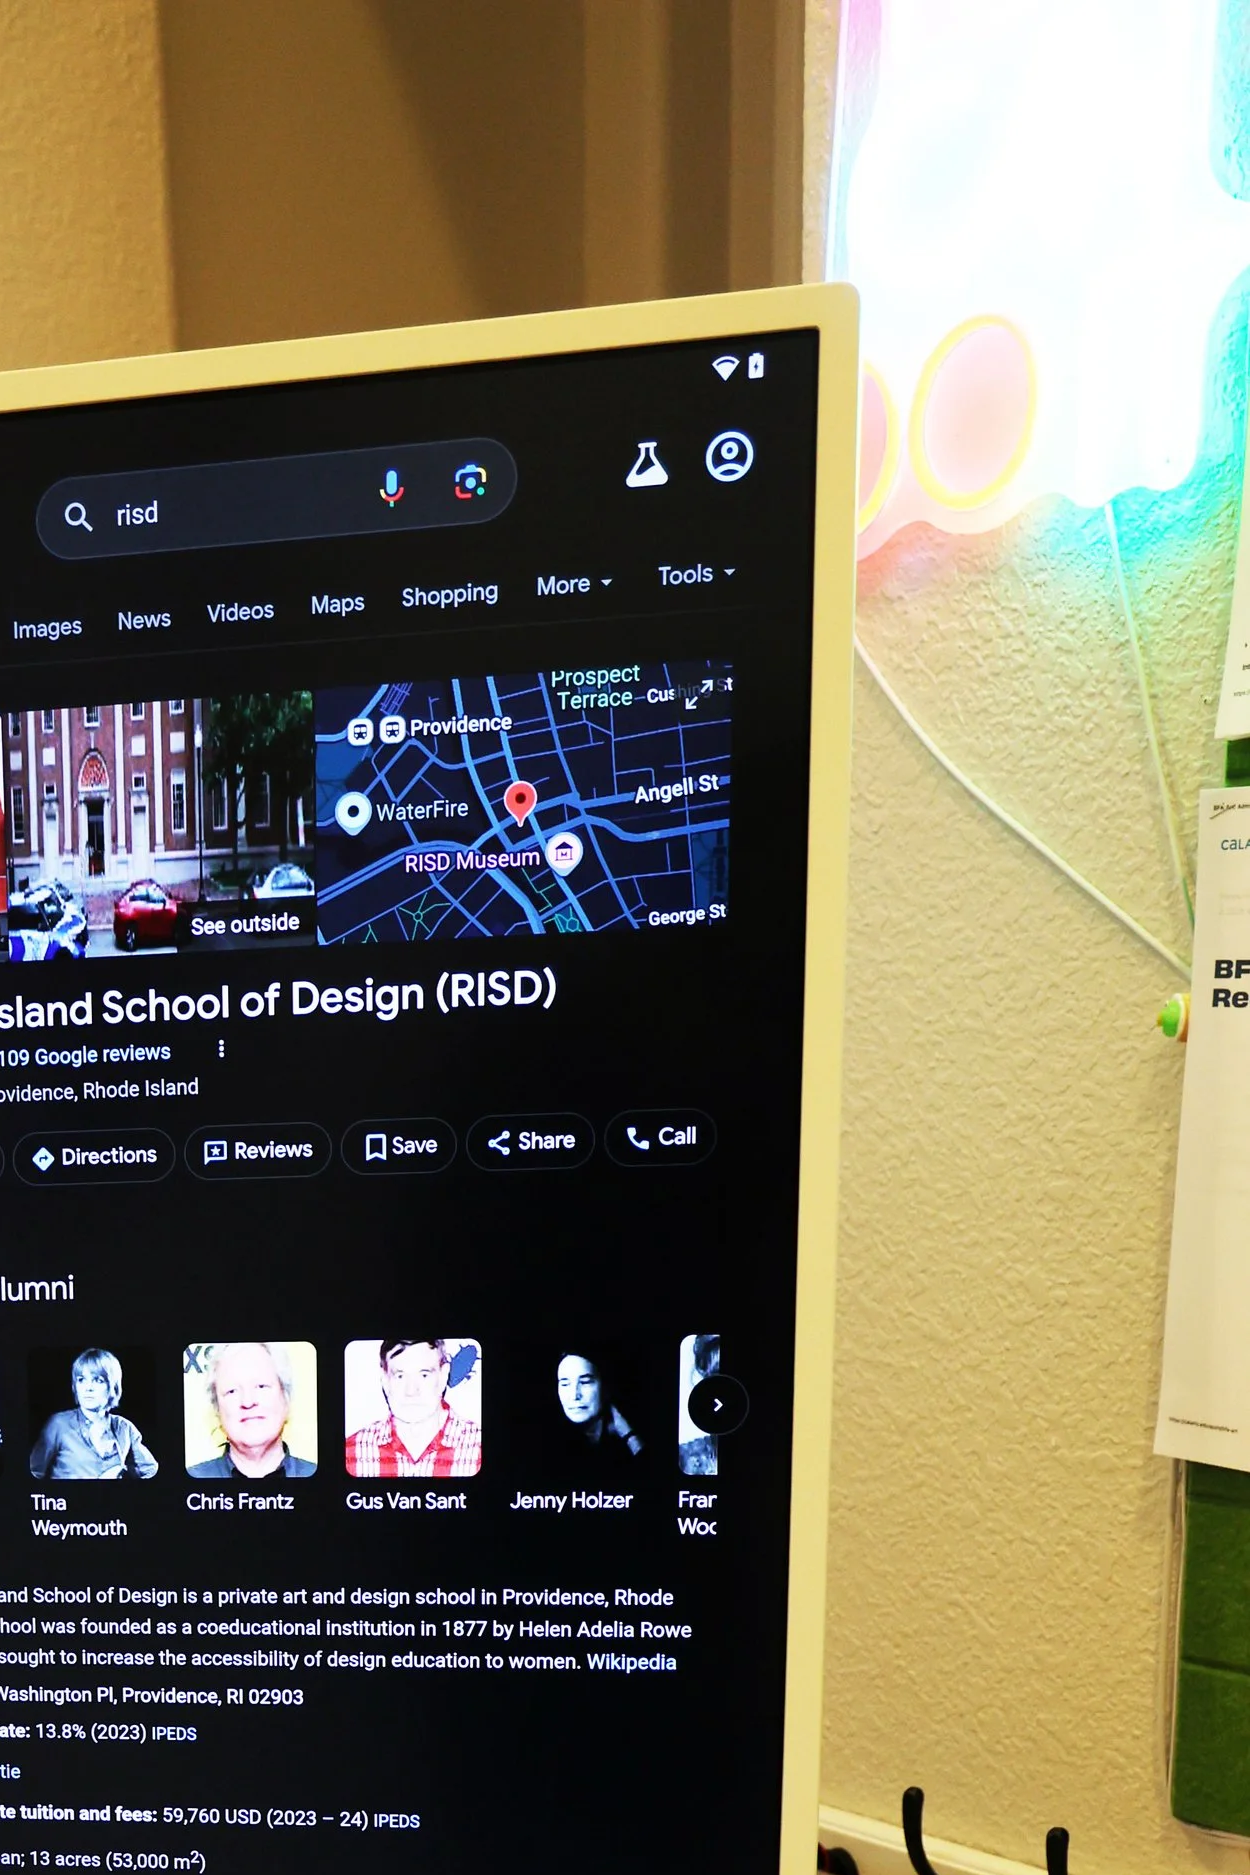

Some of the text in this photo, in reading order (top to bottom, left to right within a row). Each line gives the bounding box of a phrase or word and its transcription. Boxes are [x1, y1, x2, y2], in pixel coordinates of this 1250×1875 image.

[117, 499, 158, 527] risd
[537, 575, 591, 596] More
[658, 563, 714, 586] Tools
[311, 594, 365, 617] Maps
[402, 582, 499, 609] Shopping
[118, 611, 172, 631] News
[206, 602, 275, 623] Videos
[13, 620, 83, 641] Images
[552, 665, 640, 687] Prospect
[557, 691, 633, 710] Terrace
[410, 715, 512, 736] Providence
[635, 774, 719, 803] Angell St
[377, 800, 468, 822] WaterFire
[405, 849, 540, 873] RISD Museum
[191, 911, 300, 936] See outside
[649, 903, 726, 927] George St
[102, 984, 230, 1024] School
[240, 981, 281, 1018] of
[292, 977, 424, 1022] Design
[436, 966, 557, 1014] (RISD)
[34, 1045, 99, 1068] Google
[102, 1043, 172, 1063] reviews
[83, 1079, 140, 1100] Rhode
[145, 1076, 199, 1097] Island
[392, 1135, 438, 1155] Save
[518, 1131, 576, 1151] Share
[658, 1125, 697, 1146] Call
[61, 1145, 158, 1166] Directions
[234, 1140, 314, 1160] Reviews
[30, 1493, 67, 1511] Tina
[186, 1492, 295, 1511] Chris Frantz
[345, 1491, 467, 1510] Gus Van Sant
[509, 1491, 634, 1514] Jenny Holzer
[31, 1518, 128, 1541] Weymouth
[32, 1586, 91, 1604] School
[95, 1586, 115, 1604] of
[118, 1587, 178, 1608] Design
[182, 1587, 198, 1604] is
[202, 1591, 213, 1604] a
[218, 1587, 279, 1608] private
[282, 1588, 308, 1605] art
[312, 1587, 345, 1605] and
[350, 1587, 410, 1609] design
[415, 1587, 476, 1605] school
[481, 1588, 497, 1606] in
[502, 1587, 610, 1608] Providence,
[614, 1588, 674, 1606] Rhode
[96, 1686, 118, 1706] Pl,
[122, 1686, 222, 1707] Providence,
[226, 1688, 244, 1705] RI
[248, 1688, 304, 1706] 02903
[35, 1723, 87, 1740] 13.8%
[90, 1722, 147, 1745] (2023)
[151, 1726, 198, 1741] IPEDS
[29, 1850, 51, 1866] 13
[55, 1854, 101, 1868] acres
[105, 1850, 169, 1872] (53,000
